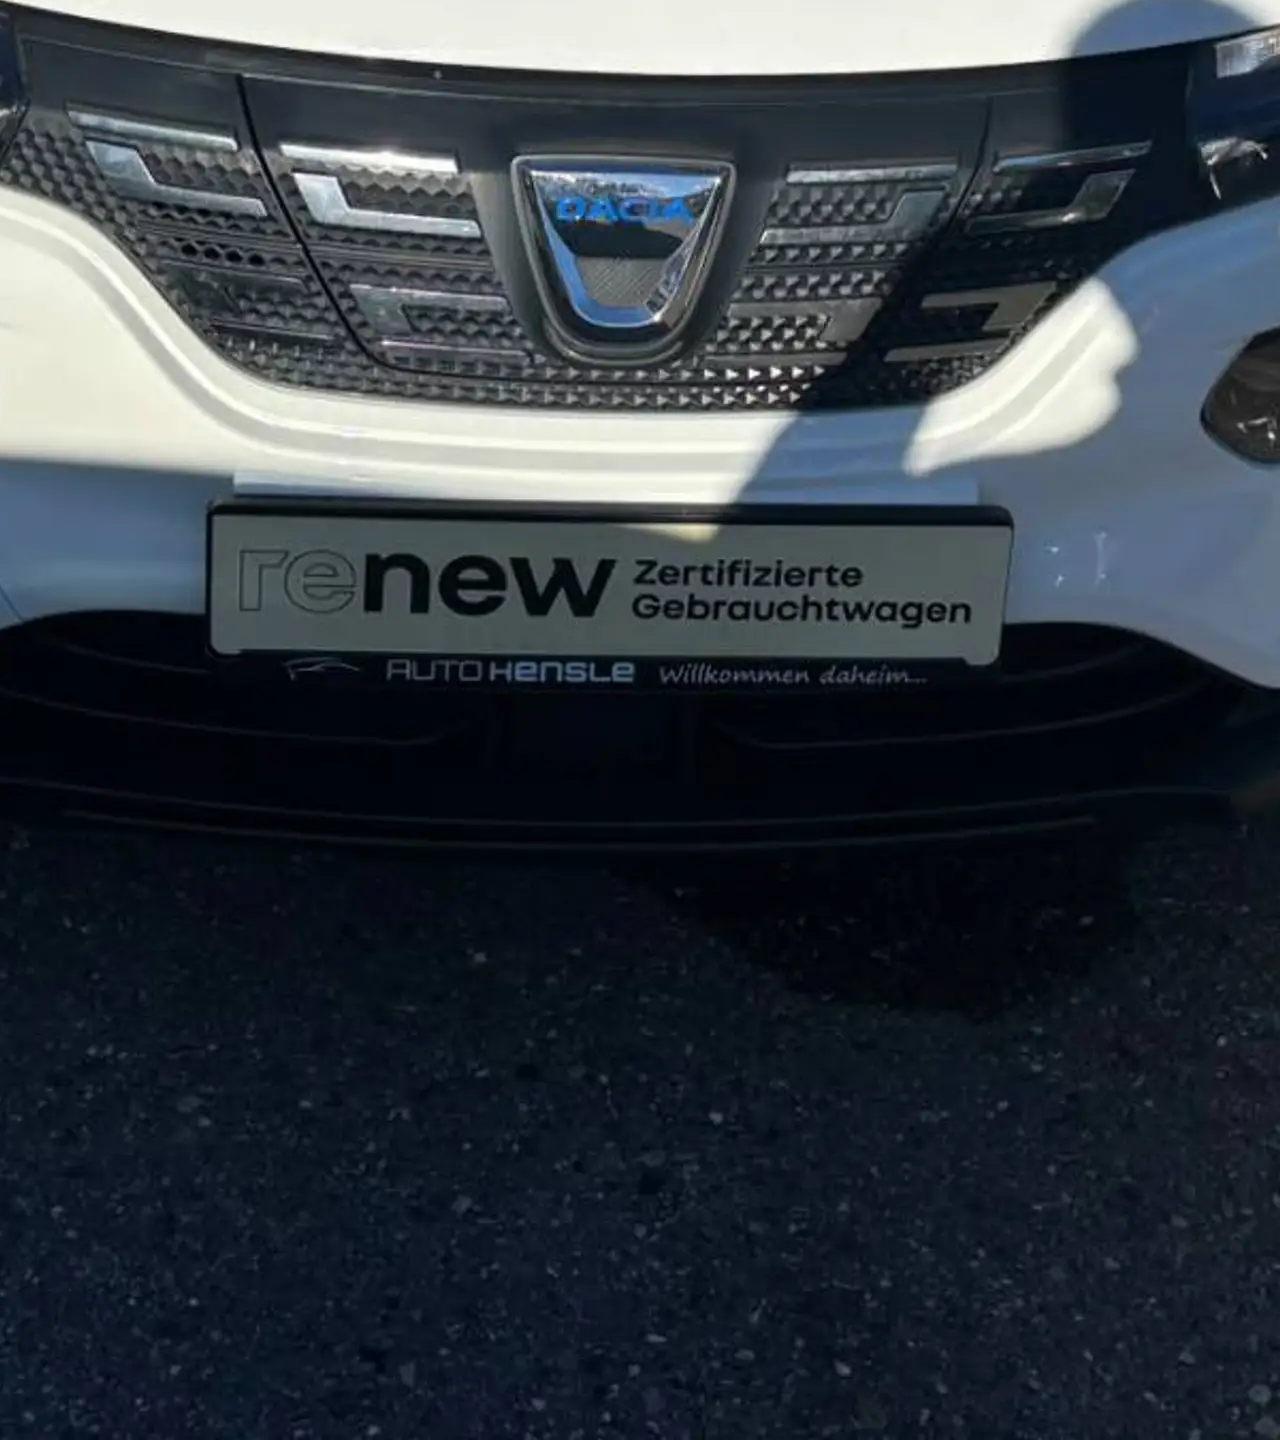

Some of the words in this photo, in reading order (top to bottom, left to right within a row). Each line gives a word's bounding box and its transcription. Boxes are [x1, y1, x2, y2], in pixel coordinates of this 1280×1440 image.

[558, 197, 695, 222] DACIA
[633, 559, 864, 588] Zertifizierte
[631, 594, 972, 629] Gebrauchtwagen
[386, 658, 484, 682] AUTO
[659, 665, 811, 685] Willkommen
